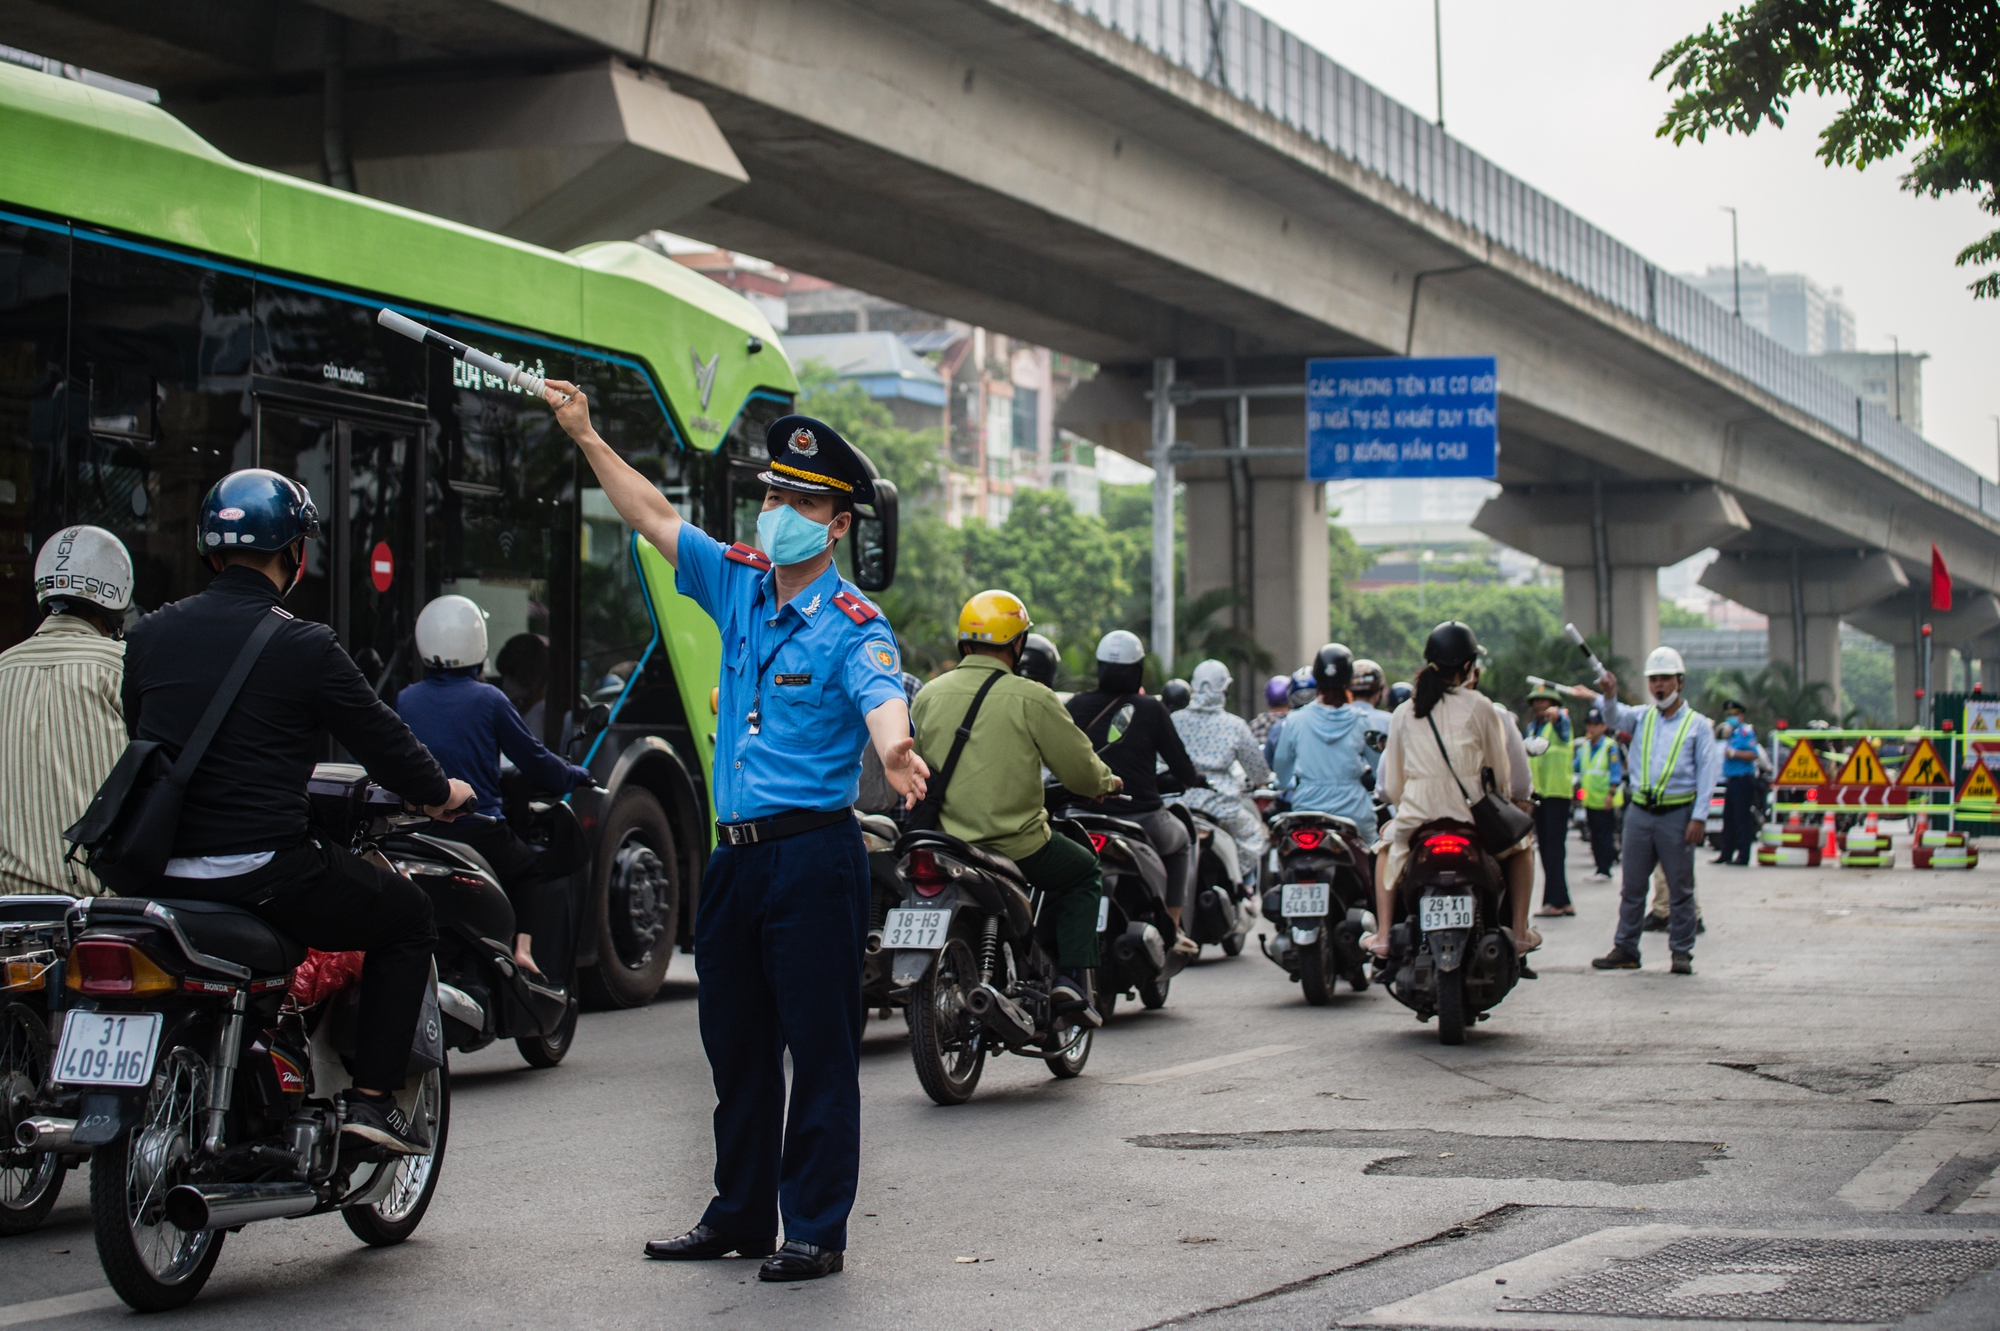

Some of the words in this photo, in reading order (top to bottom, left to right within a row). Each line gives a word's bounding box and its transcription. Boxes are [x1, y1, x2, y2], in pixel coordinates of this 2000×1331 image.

[340, 365, 365, 385] XUỐNG
[1309, 374, 1336, 398] CÁC
[1429, 376, 1446, 395] XE
[1438, 409, 1463, 428] DUY
[1436, 441, 1468, 461] CHUI
[1429, 898, 1465, 912] 29-X1
[898, 912, 941, 928] 18-H3
[1425, 912, 1470, 927] 931.30
[891, 929, 937, 945] 3217
[204, 982, 229, 993] HONDA
[266, 979, 285, 988] HONDA
[99, 1017, 127, 1046] 31
